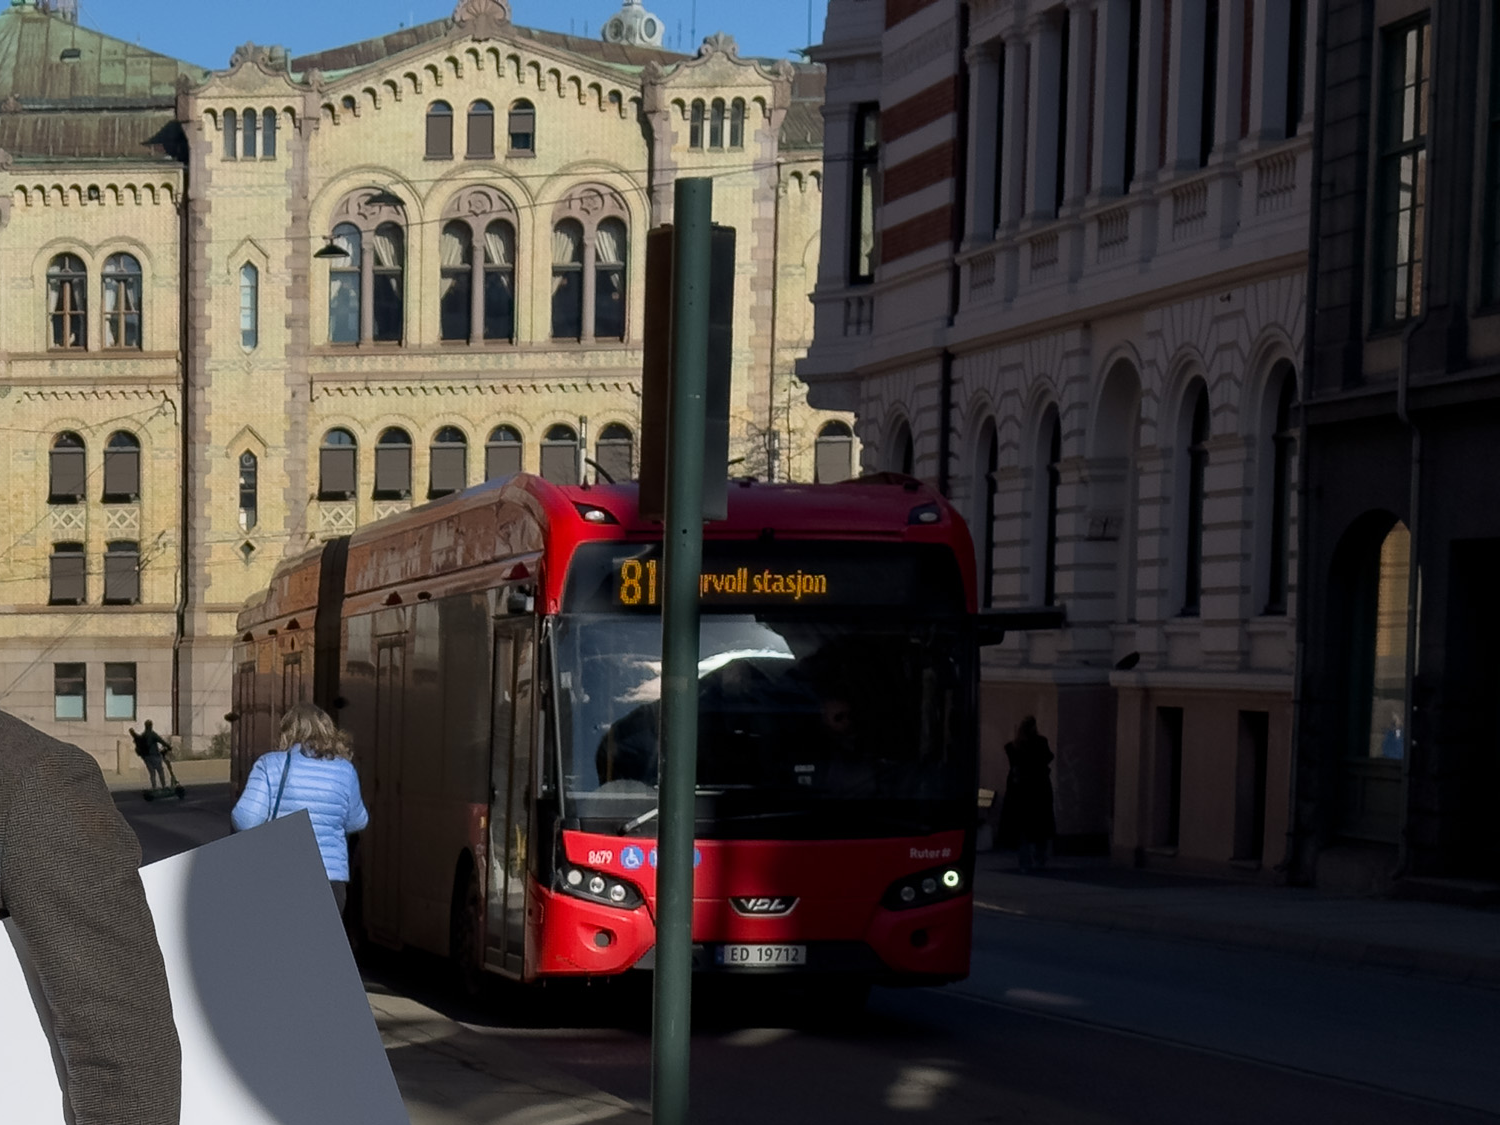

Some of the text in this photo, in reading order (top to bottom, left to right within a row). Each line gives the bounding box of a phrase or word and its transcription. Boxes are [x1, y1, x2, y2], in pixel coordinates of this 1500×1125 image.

[621, 559, 656, 604] 81
[752, 569, 827, 600] stasjon
[588, 850, 612, 864] 8679
[740, 898, 786, 911] VDL
[731, 947, 799, 962] ED 19712
